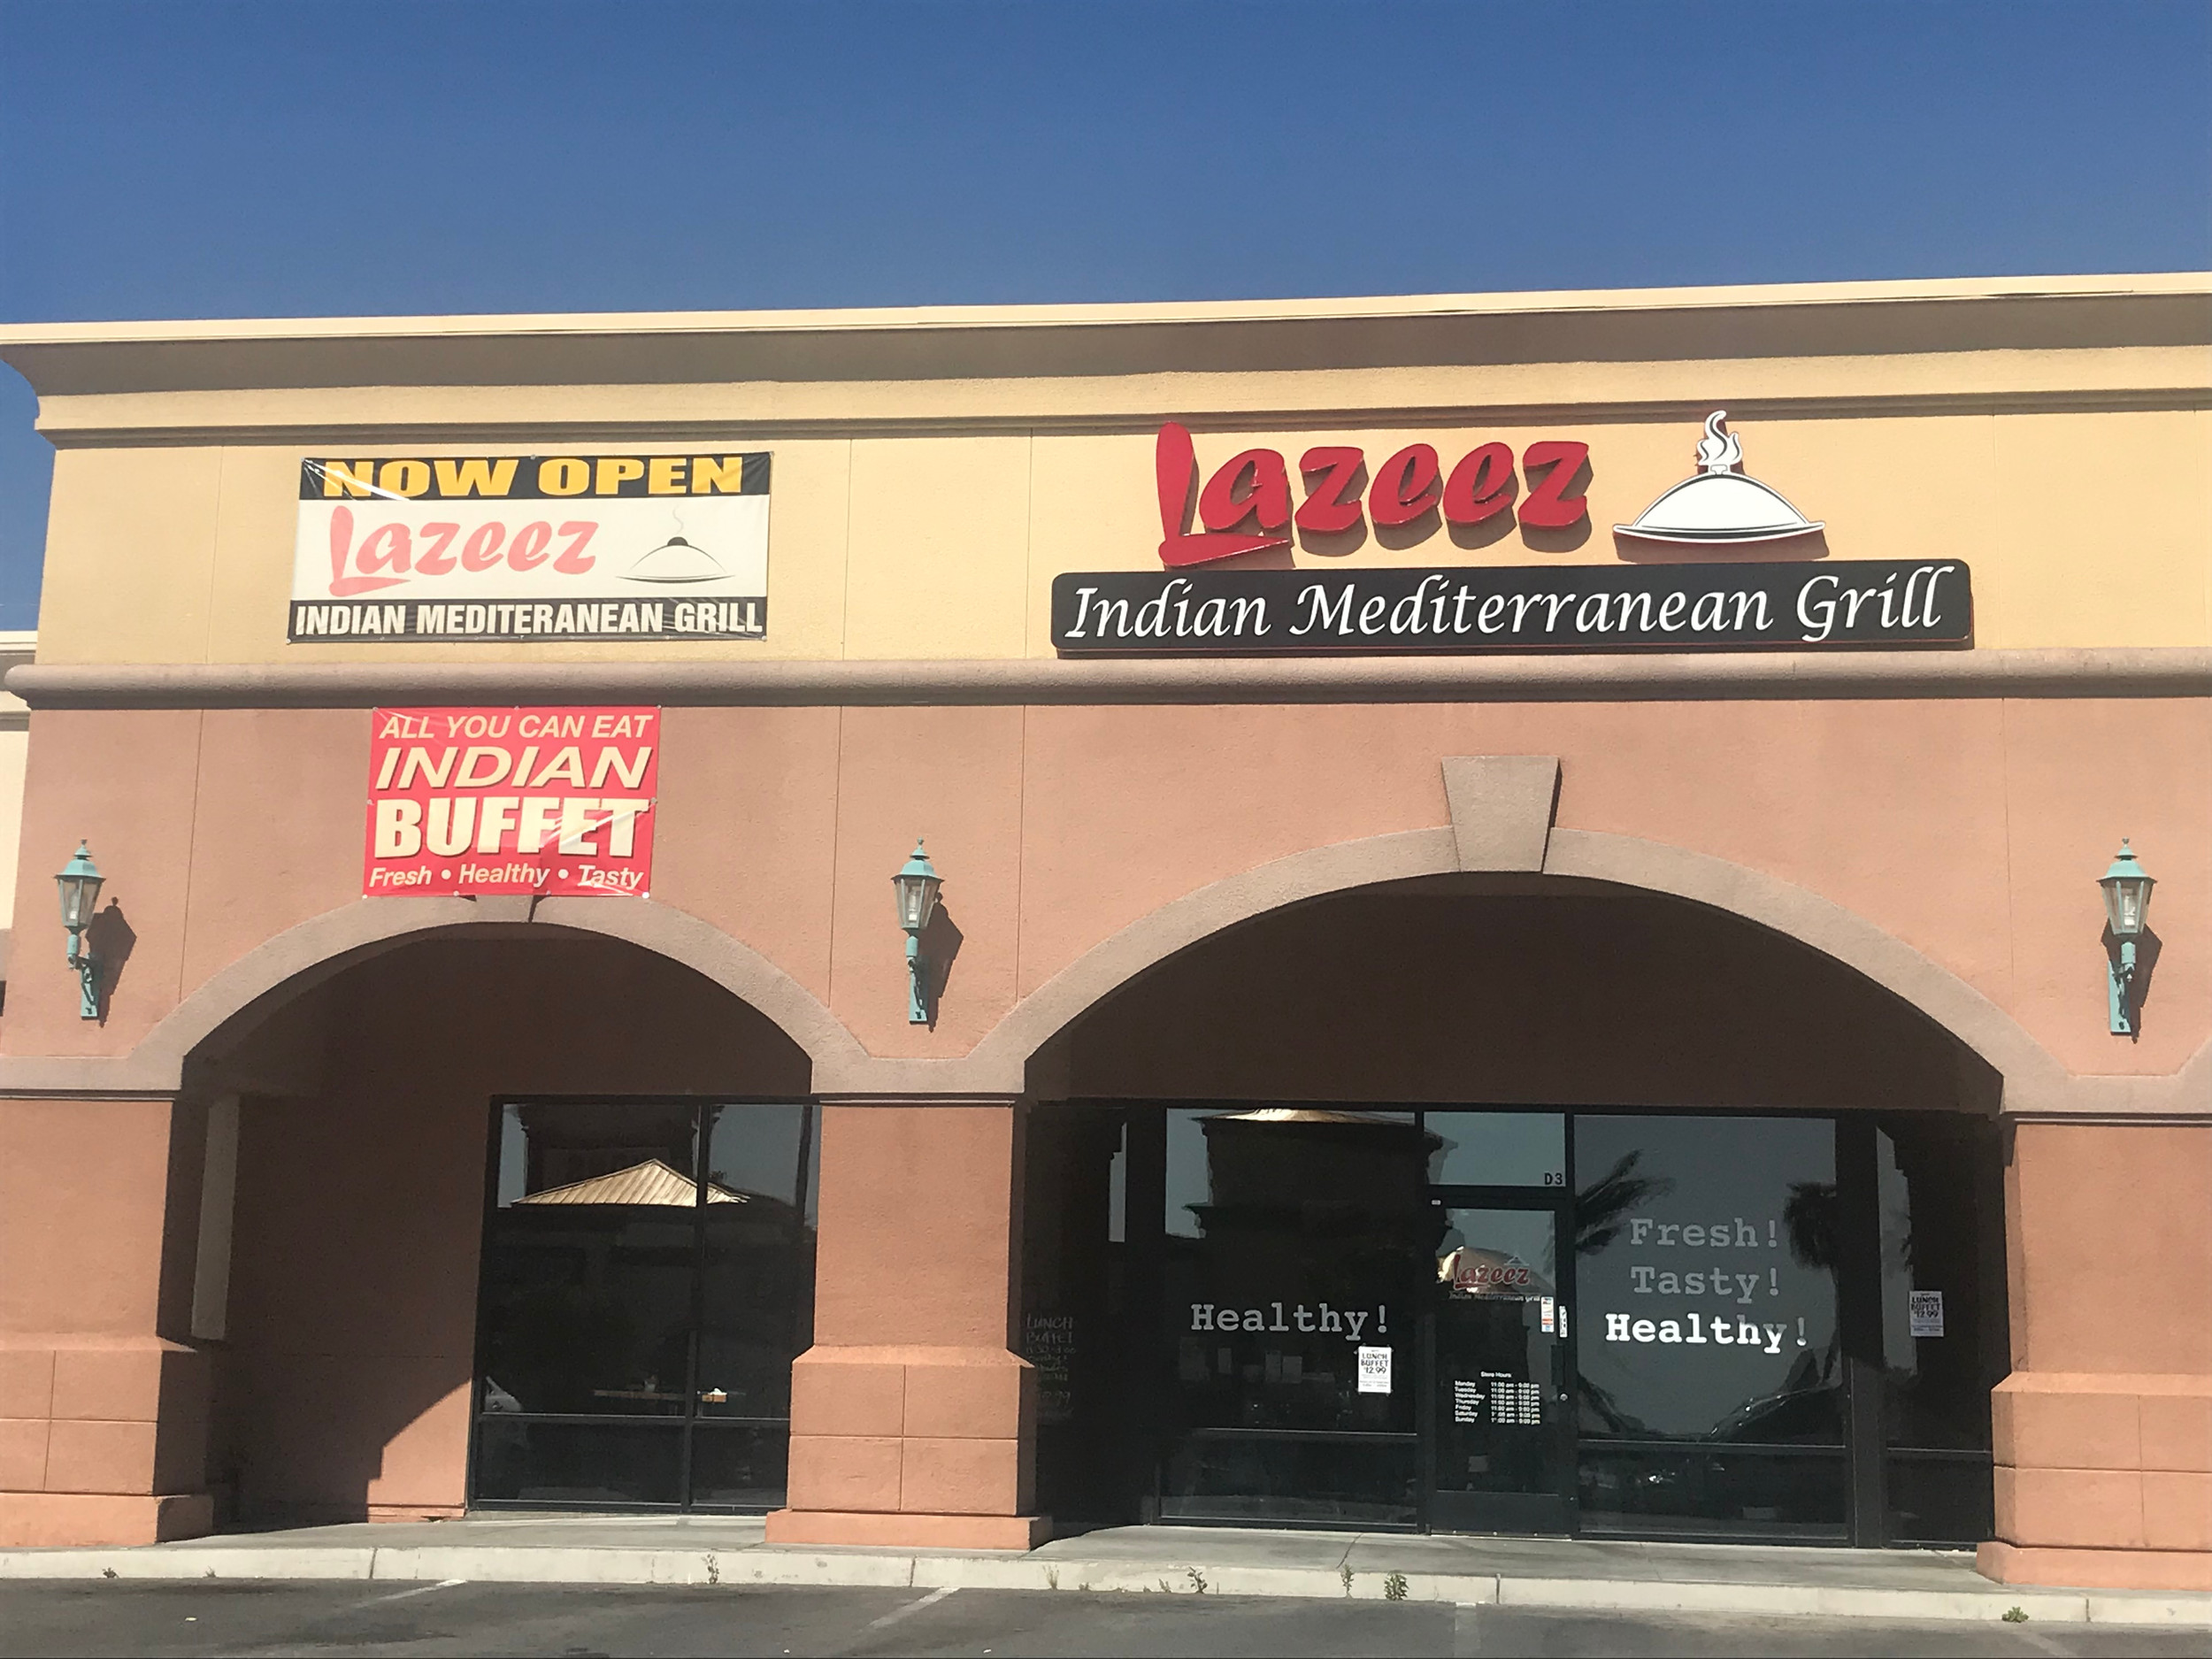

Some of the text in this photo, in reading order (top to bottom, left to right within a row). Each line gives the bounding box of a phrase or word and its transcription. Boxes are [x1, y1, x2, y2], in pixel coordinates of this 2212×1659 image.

[323, 457, 743, 497] NOW OPEN
[1156, 421, 1590, 567] Lazeez
[329, 504, 600, 597] Lazeez
[296, 602, 763, 635] INDIAN MEDITERANEAN GRILL
[1064, 564, 1954, 642] Indian Mediterranean Grill
[379, 715, 653, 739] ALL YOU CAN EAT
[375, 746, 653, 789] INDIAN
[374, 796, 649, 858] BUFFET
[369, 863, 644, 889] Fresh Healthy Tasty
[1544, 1172, 1563, 1186] D3
[1630, 1217, 1778, 1248] Fresh!
[1453, 1254, 1531, 1290] Lazeez
[1631, 1266, 1778, 1303] Tasty!
[1191, 1302, 1387, 1340] Healthy!
[1605, 1313, 1807, 1354] Healthy!
